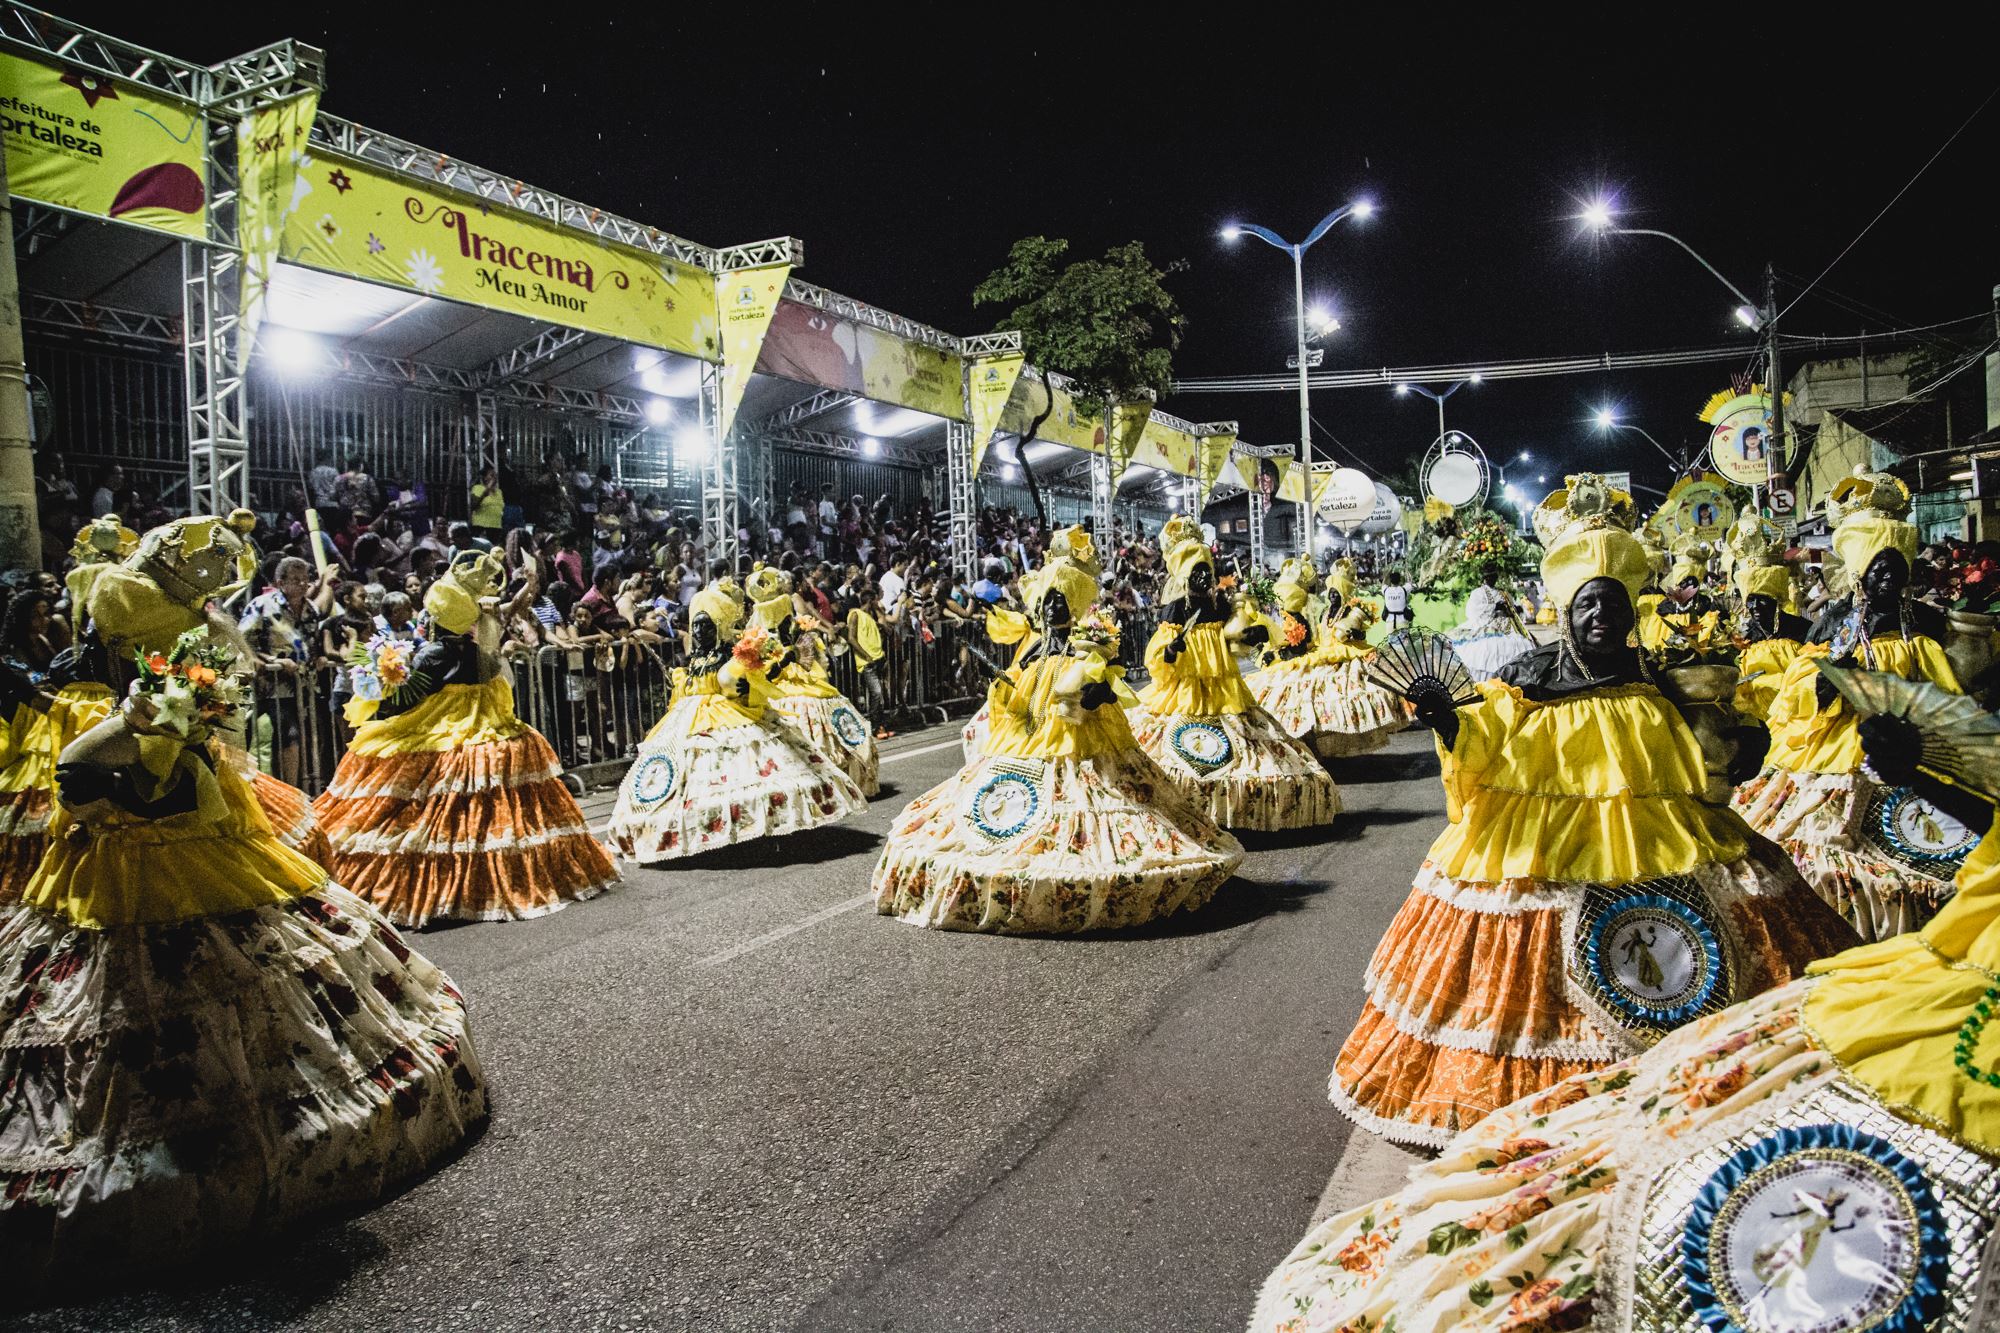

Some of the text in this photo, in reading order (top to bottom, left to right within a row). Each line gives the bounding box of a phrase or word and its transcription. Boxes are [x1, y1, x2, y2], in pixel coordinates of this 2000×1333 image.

[0, 97, 101, 135] efeitura de
[0, 116, 103, 158] ortaleza
[405, 197, 629, 293] Iracema
[476, 268, 588, 313] Meu Amor
[728, 311, 765, 322] Fortaleza
[1731, 462, 1767, 471] Iracem
[1321, 495, 1348, 503] efeitura
[1776, 494, 1787, 508] E
[1320, 502, 1357, 512] Fortaleza
[1367, 514, 1392, 522] rtaleza
